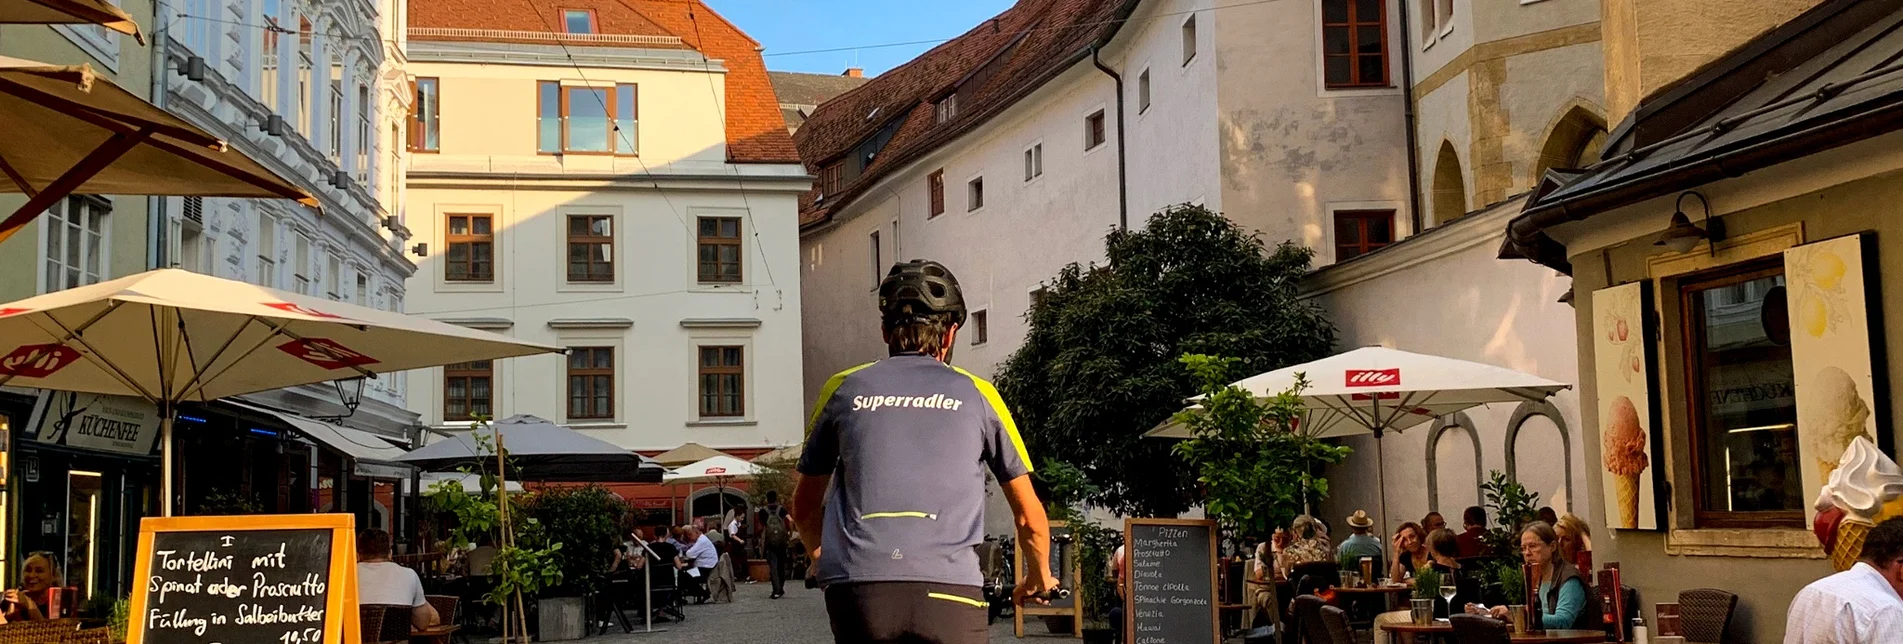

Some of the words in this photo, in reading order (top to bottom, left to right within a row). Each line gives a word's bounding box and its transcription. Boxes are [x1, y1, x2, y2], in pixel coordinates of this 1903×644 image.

[1350, 371, 1395, 385] illy
[853, 393, 963, 411] Superradler
[78, 414, 141, 442] KÜCHENFEE
[1159, 527, 1188, 538] Pizzen
[1134, 538, 1178, 549] Margherita
[157, 550, 233, 572] Tortellini
[251, 542, 286, 569] mit
[149, 573, 202, 604] Spinat
[252, 571, 326, 599] Prosciutto
[149, 608, 207, 636] Füllung
[210, 612, 227, 625] in
[234, 603, 324, 625] Salbeibutter
[280, 628, 322, 644] 10,50
